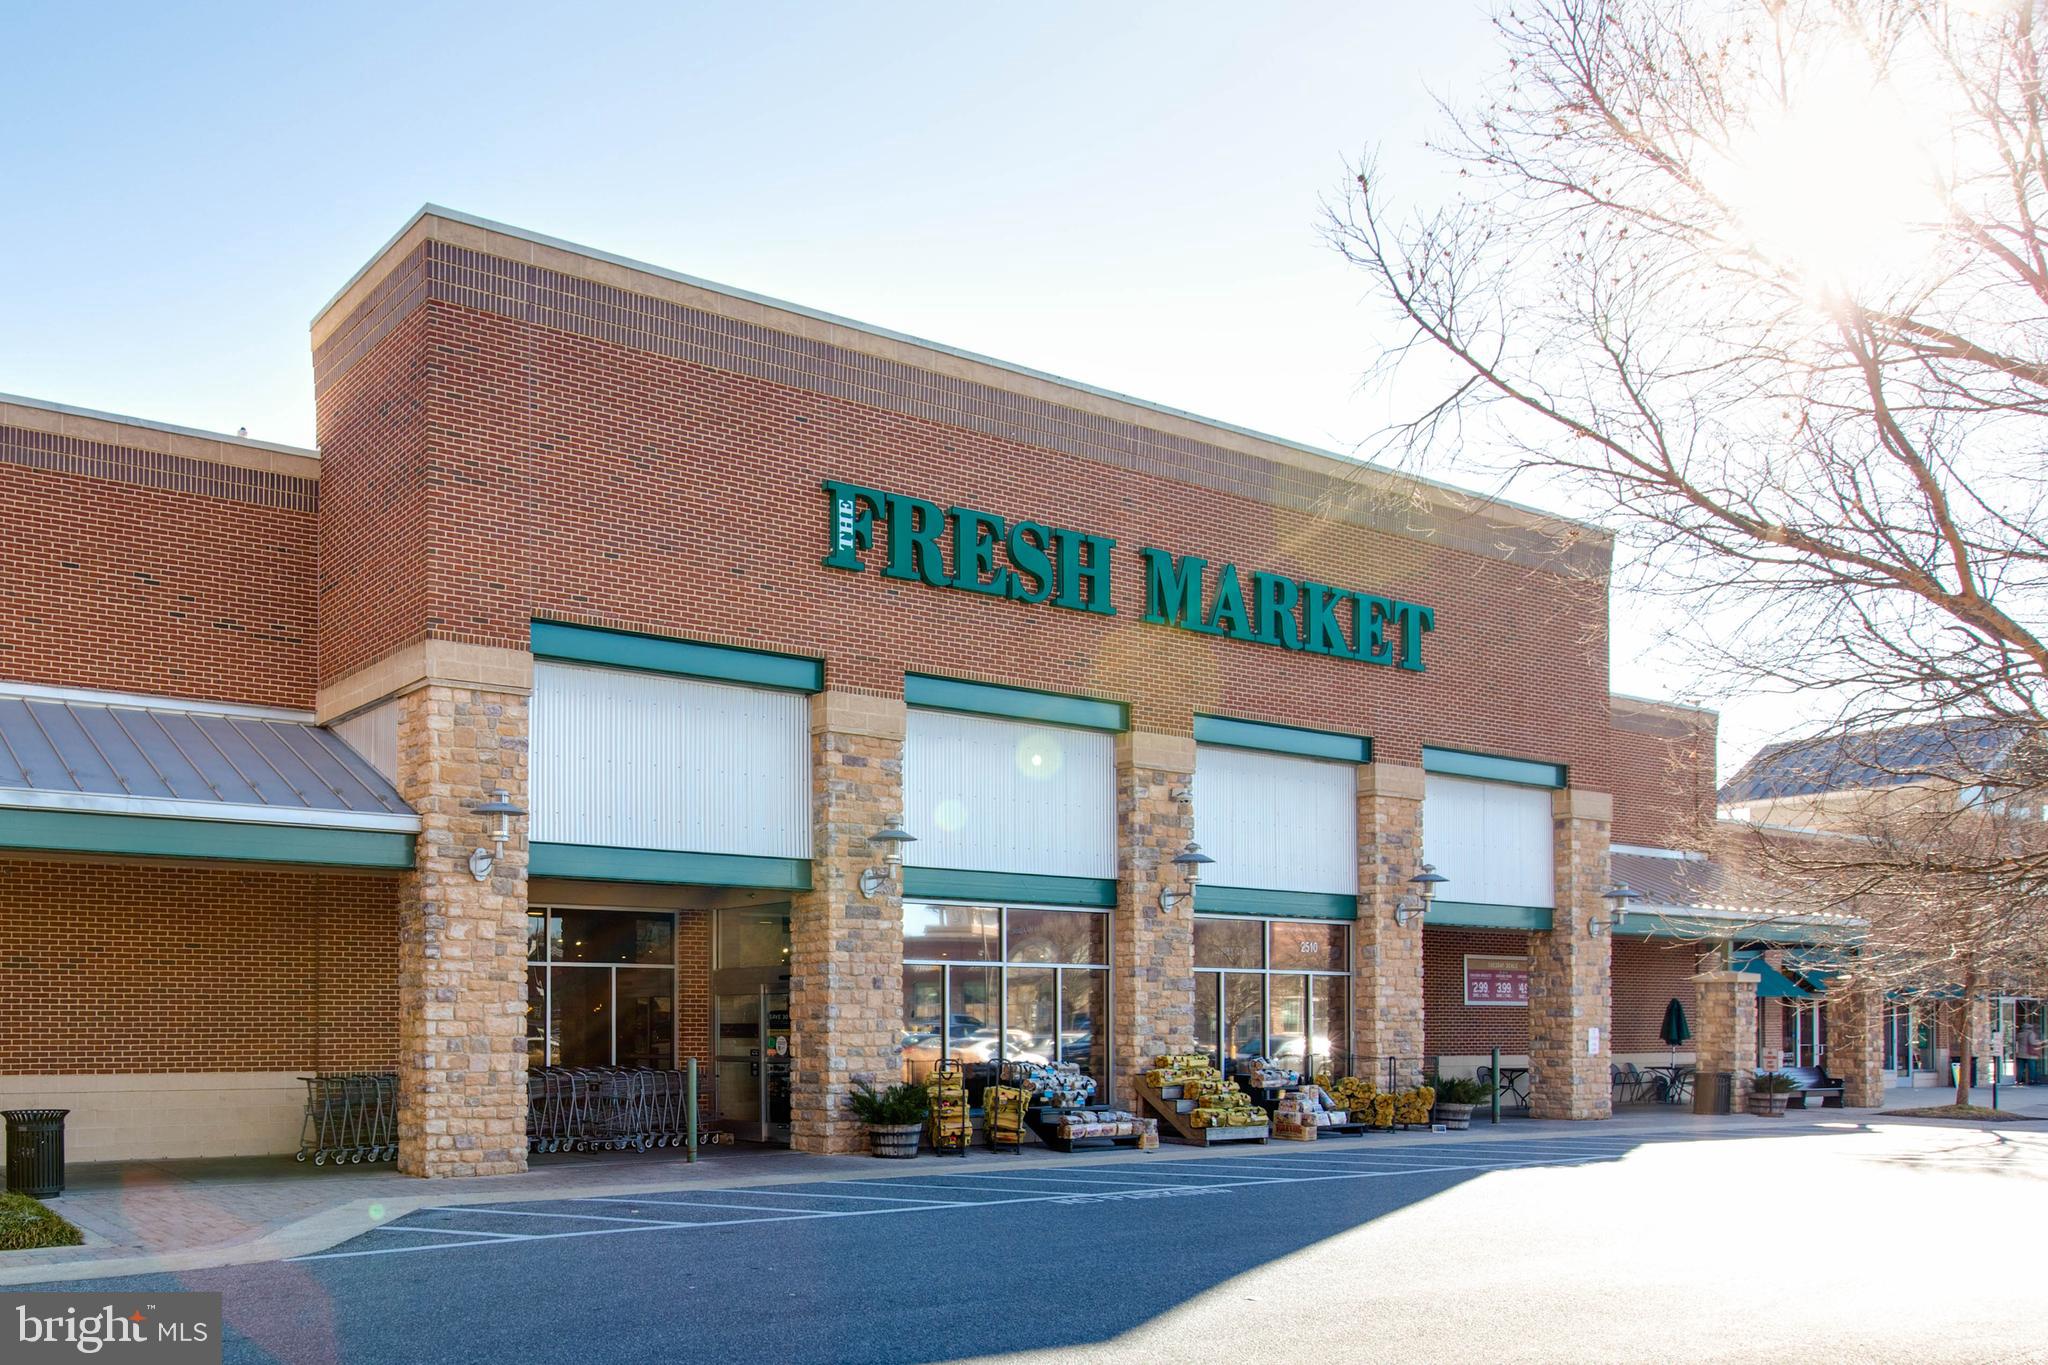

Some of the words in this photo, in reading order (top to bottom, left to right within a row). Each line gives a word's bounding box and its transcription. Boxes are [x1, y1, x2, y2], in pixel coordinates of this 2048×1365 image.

[822, 479, 1117, 615] FRESH
[838, 499, 854, 551] THE
[1139, 547, 1435, 672] MARKET
[1300, 941, 1318, 953] 2510
